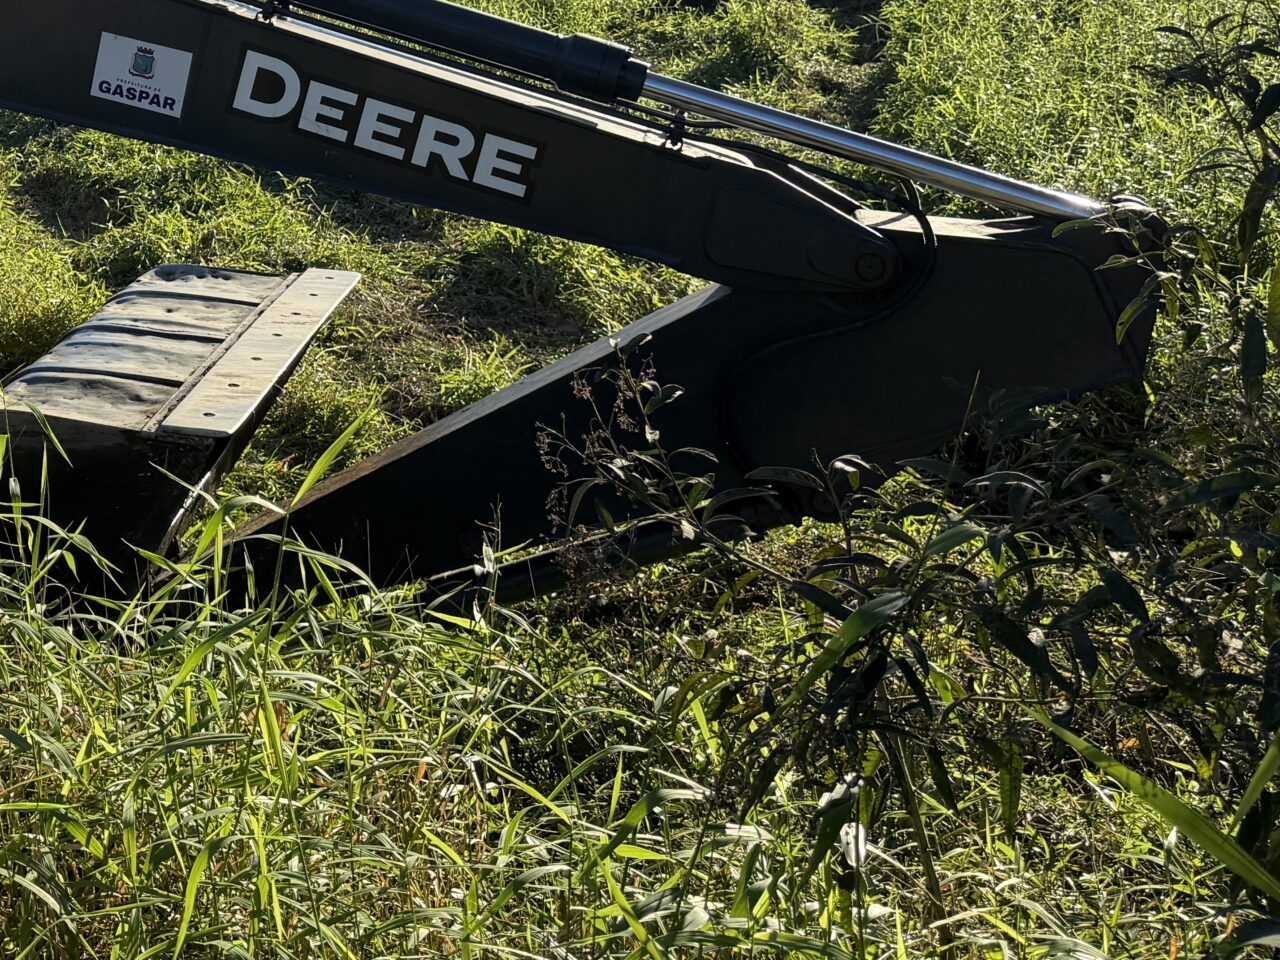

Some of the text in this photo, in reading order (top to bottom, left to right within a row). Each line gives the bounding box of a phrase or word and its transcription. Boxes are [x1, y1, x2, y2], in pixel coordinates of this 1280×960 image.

[98, 80, 176, 111] GASPAR
[116, 78, 152, 90] PREFEITURA
[232, 49, 538, 198] DEERE
